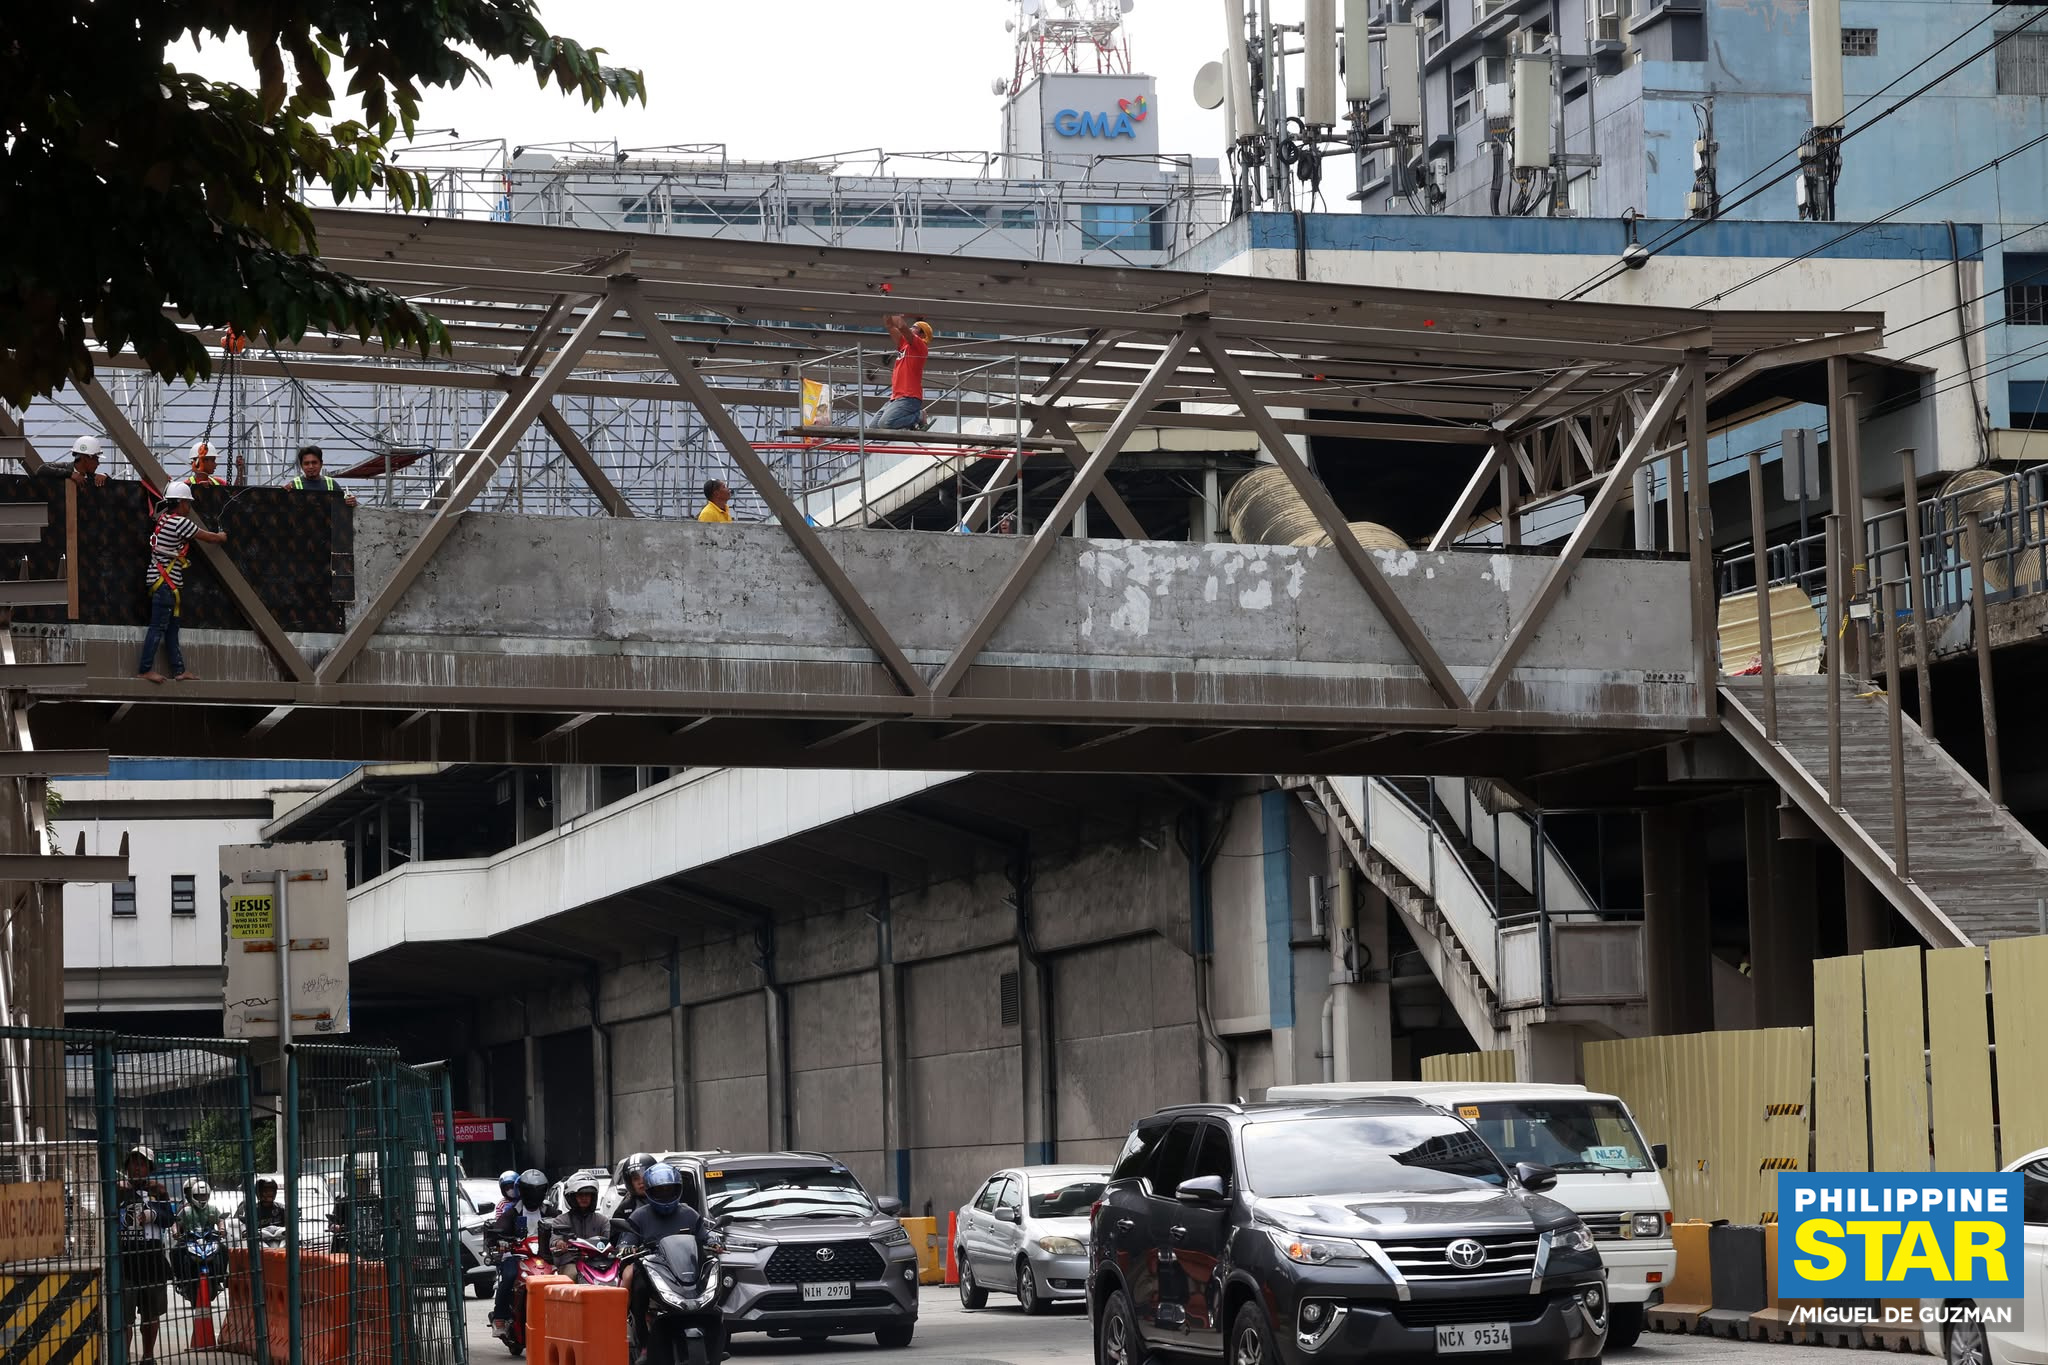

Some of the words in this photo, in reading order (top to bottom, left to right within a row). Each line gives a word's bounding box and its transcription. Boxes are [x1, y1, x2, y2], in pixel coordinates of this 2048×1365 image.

[1054, 109, 1136, 138] GMA
[233, 899, 271, 911] JESUS
[455, 1125, 493, 1134] CAROUSEL
[804, 1287, 821, 1297] NIH
[827, 1285, 850, 1297] 2970
[1440, 1331, 1464, 1346] NCX
[1474, 1329, 1508, 1345] 9534
